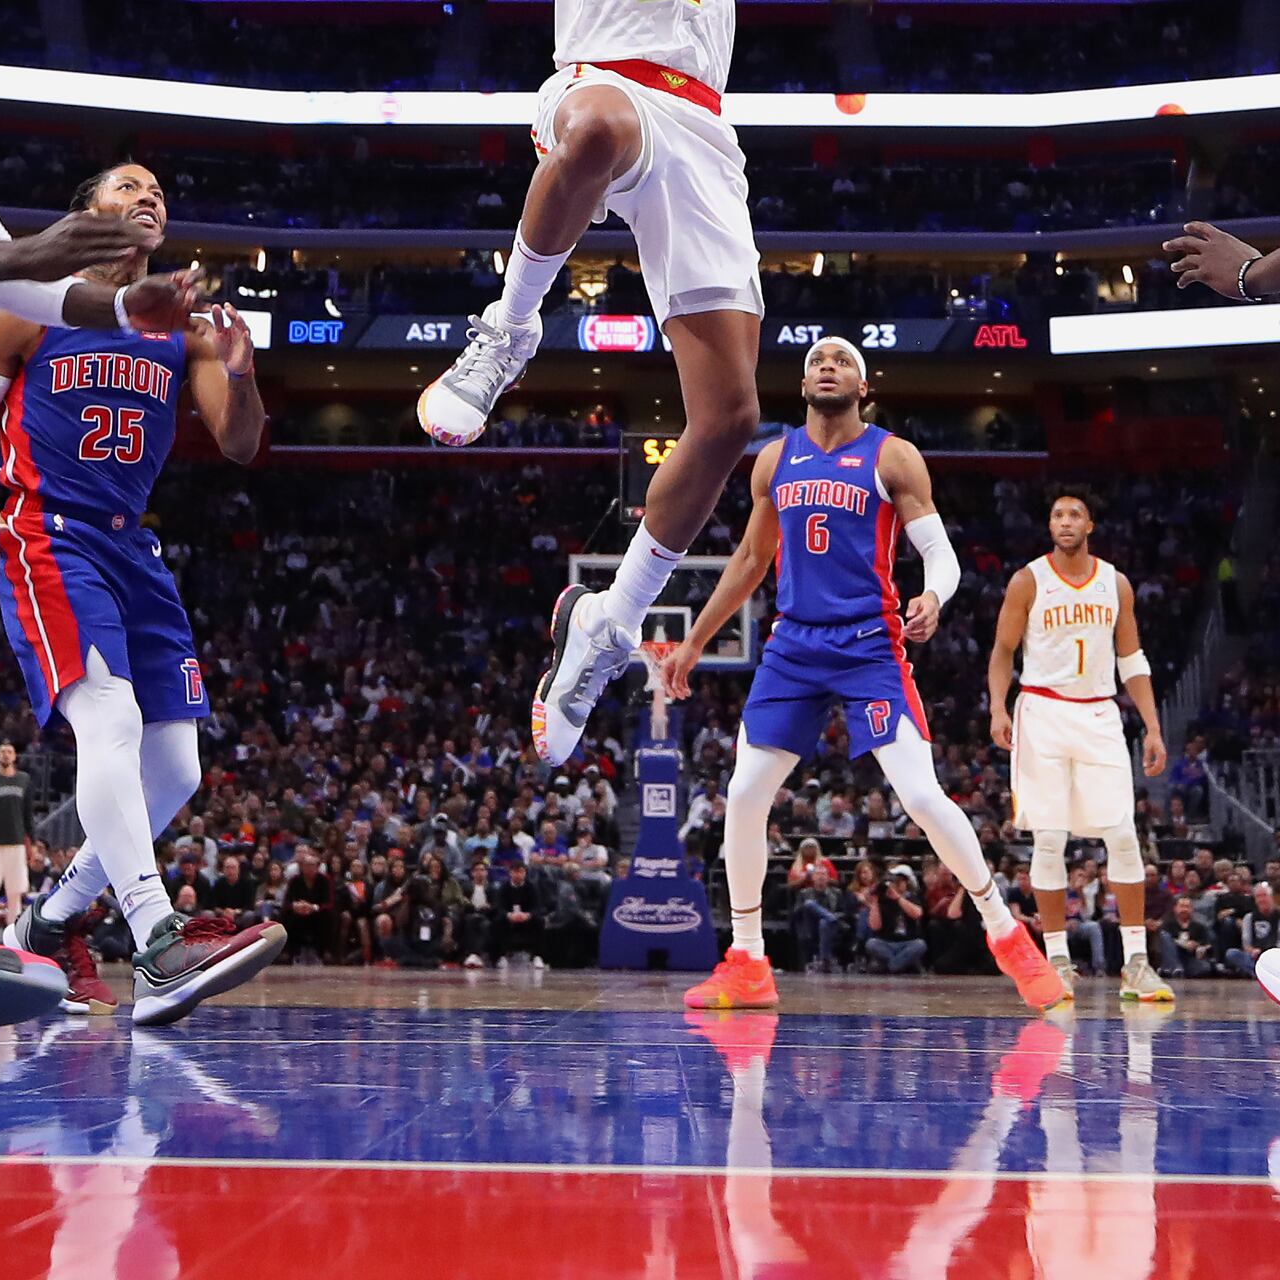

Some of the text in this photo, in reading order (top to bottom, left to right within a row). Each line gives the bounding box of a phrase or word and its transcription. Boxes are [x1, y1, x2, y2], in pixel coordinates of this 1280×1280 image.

[288, 321, 451, 343] DET AST
[776, 324, 1027, 348] AST 23 ATL
[50, 353, 172, 404] DETROIT
[79, 405, 145, 464] 25
[776, 479, 869, 516] DETROIT
[806, 513, 830, 554] 6
[1043, 603, 1114, 630] ATLANTA
[1075, 639, 1085, 676] 1
